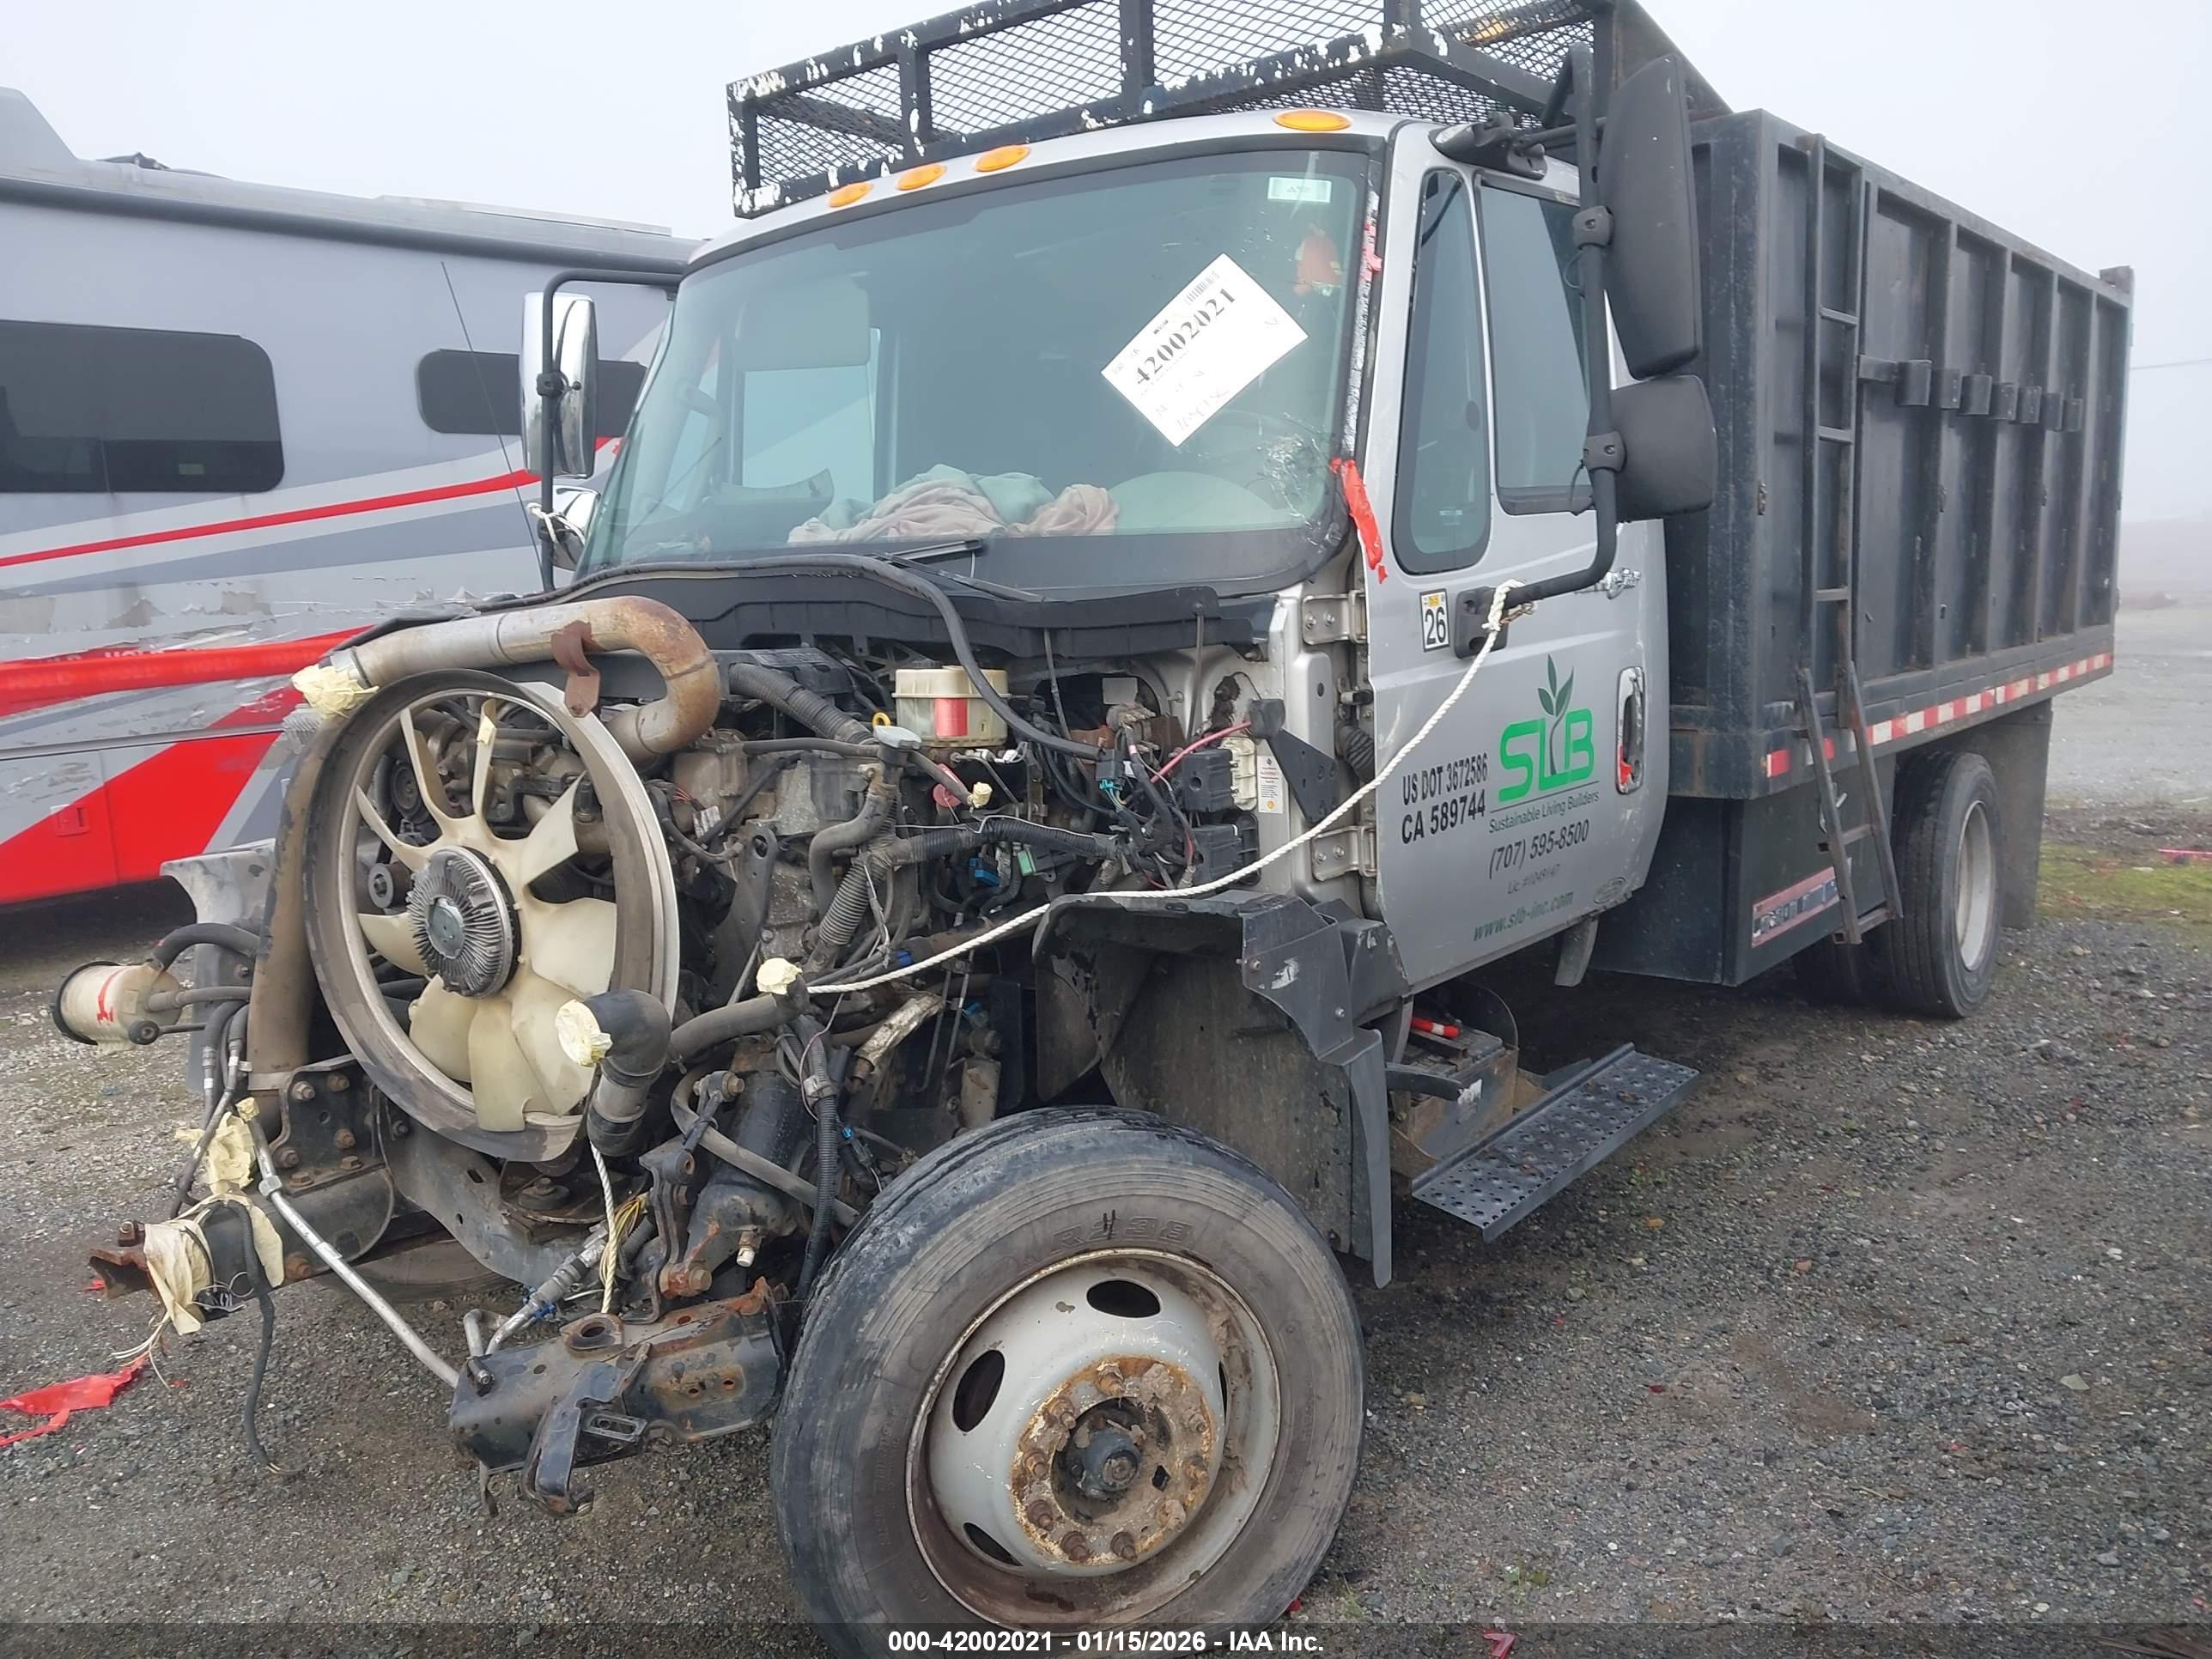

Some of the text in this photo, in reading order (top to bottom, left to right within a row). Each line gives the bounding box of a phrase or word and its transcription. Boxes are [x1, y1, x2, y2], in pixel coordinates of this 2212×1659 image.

[1137, 288, 1236, 385] 42002021
[1425, 606, 1446, 645] 26
[1498, 708, 1595, 802] SLB
[1402, 774, 1418, 805] US
[1422, 766, 1444, 800] DOT
[1488, 791, 1600, 834] Sustainable Living Builders
[1401, 789, 1486, 844] CA 589744
[1489, 819, 1589, 879] (707) 595-8500
